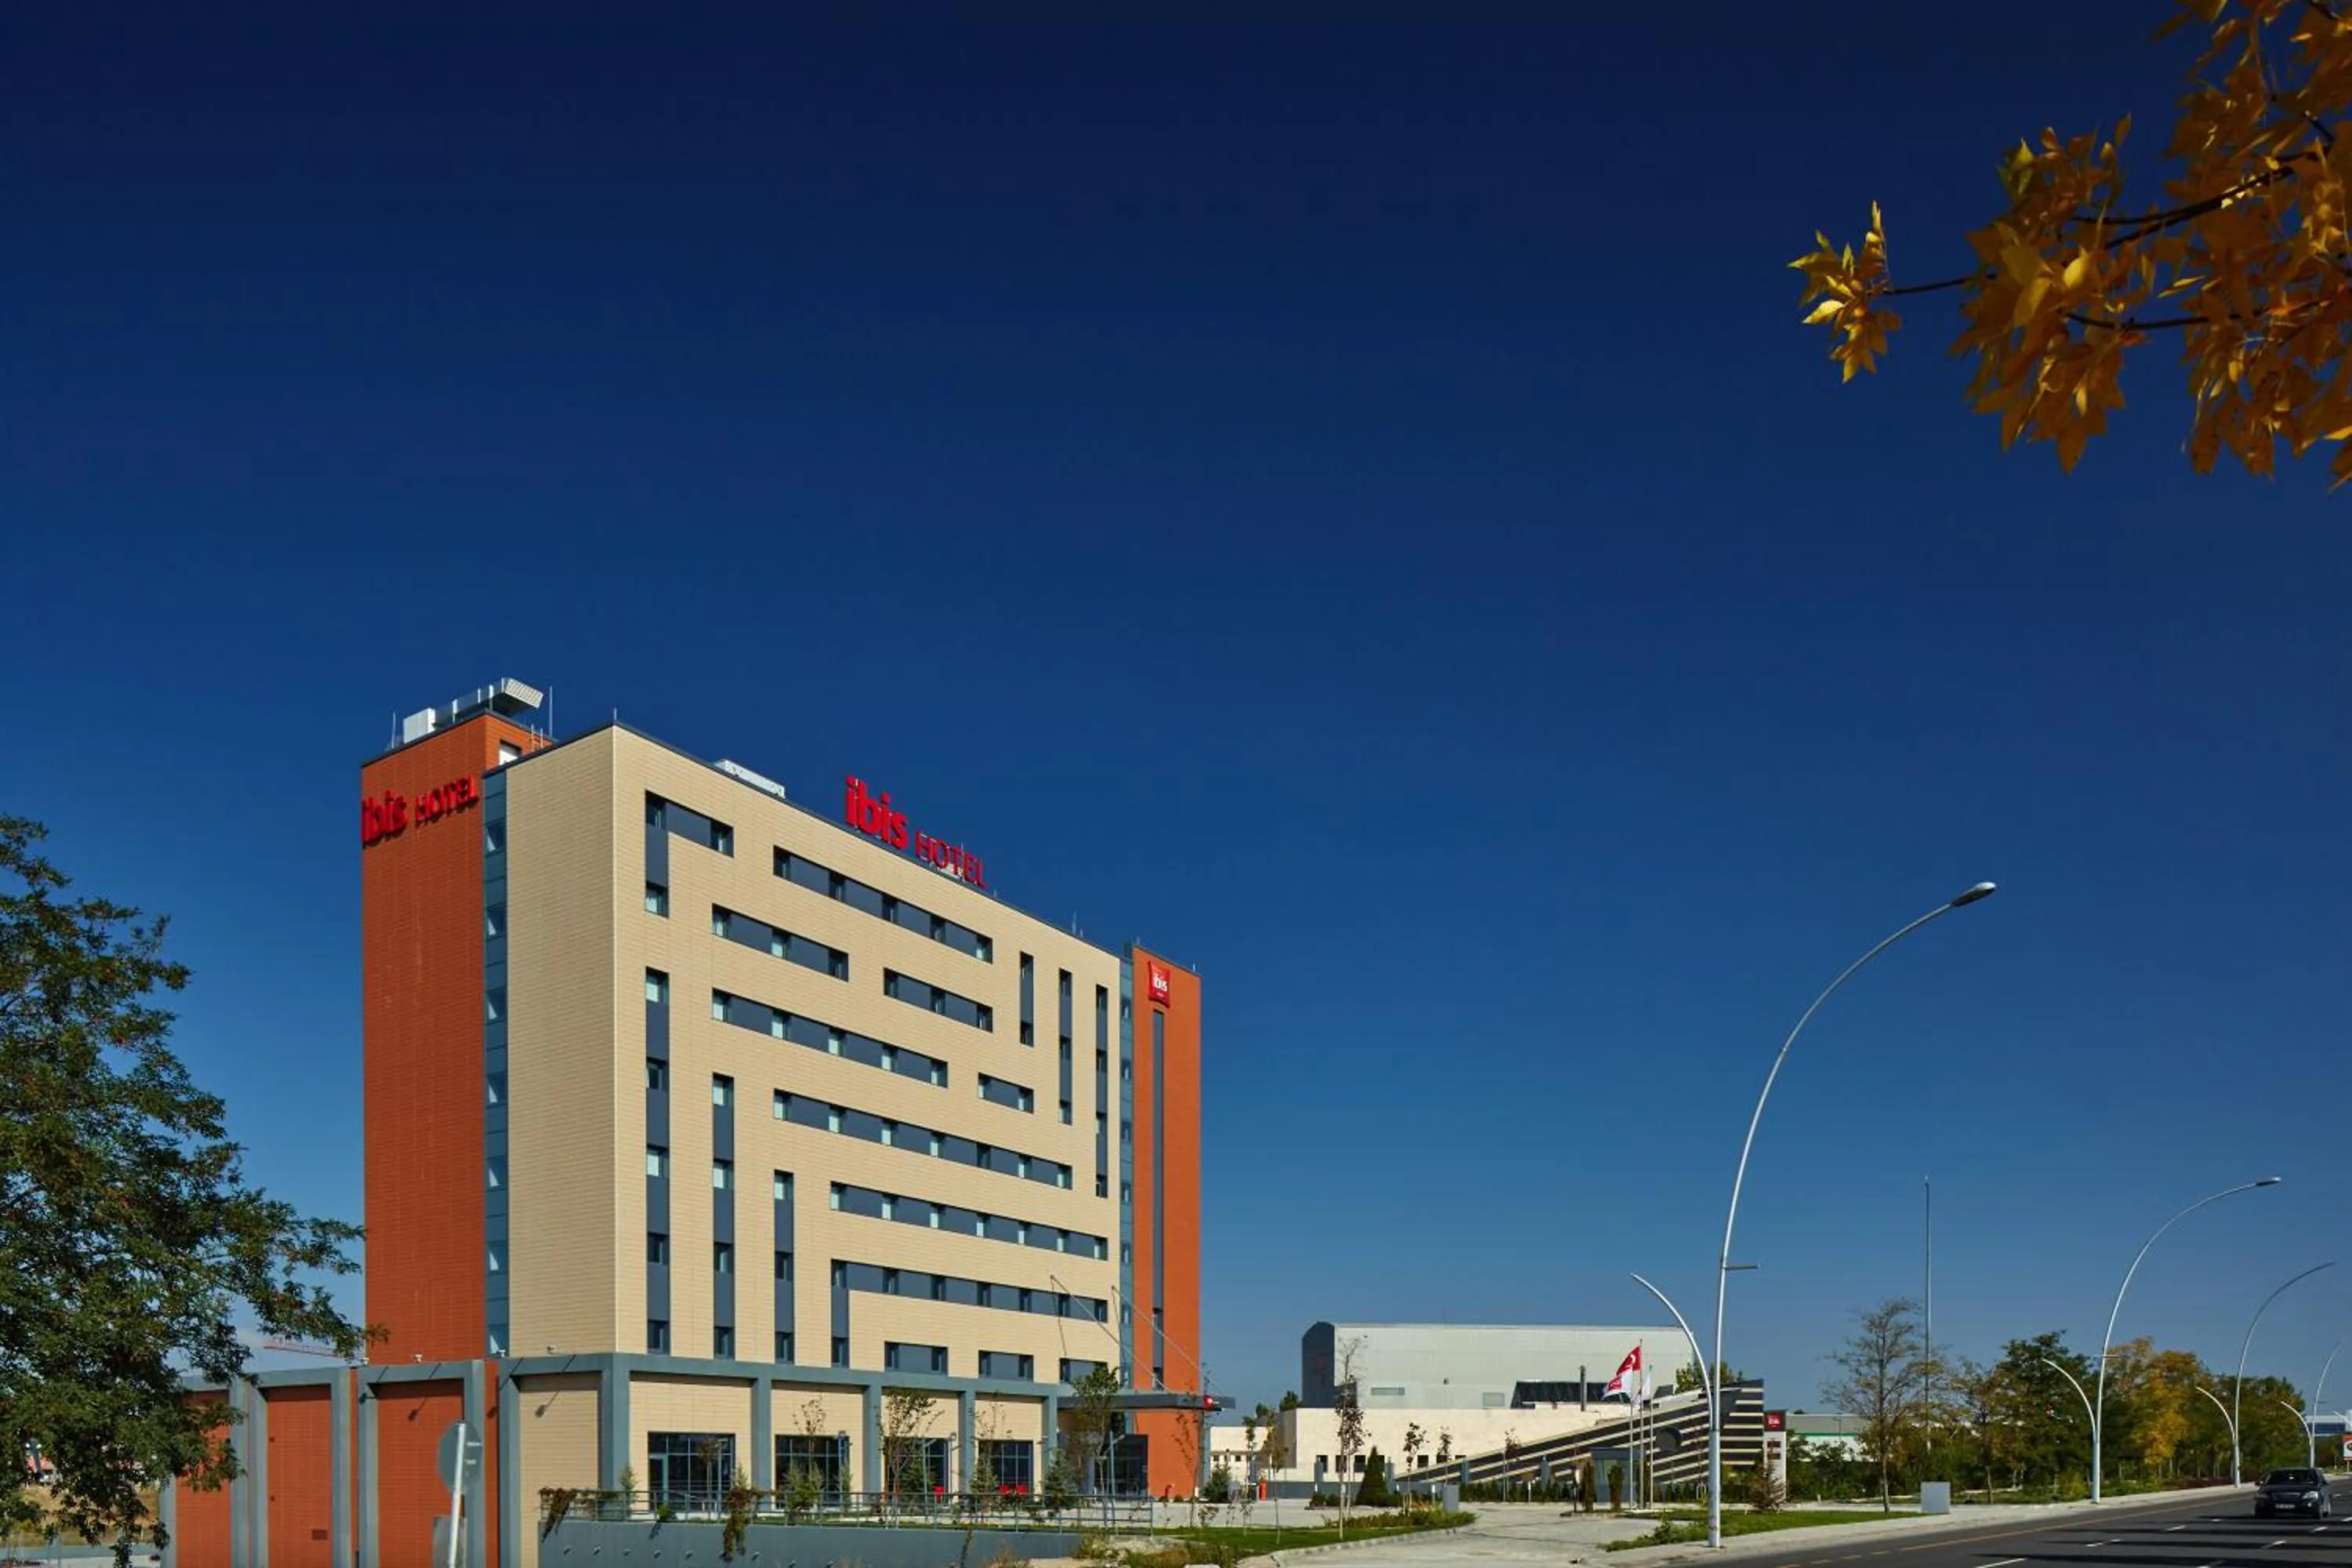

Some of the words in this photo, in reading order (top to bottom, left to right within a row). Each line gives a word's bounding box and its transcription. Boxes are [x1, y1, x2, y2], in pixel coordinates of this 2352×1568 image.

[362, 790, 408, 841] ibis
[416, 775, 477, 821] HOTEL
[846, 775, 909, 850] ibis
[916, 830, 987, 890] HOTEL
